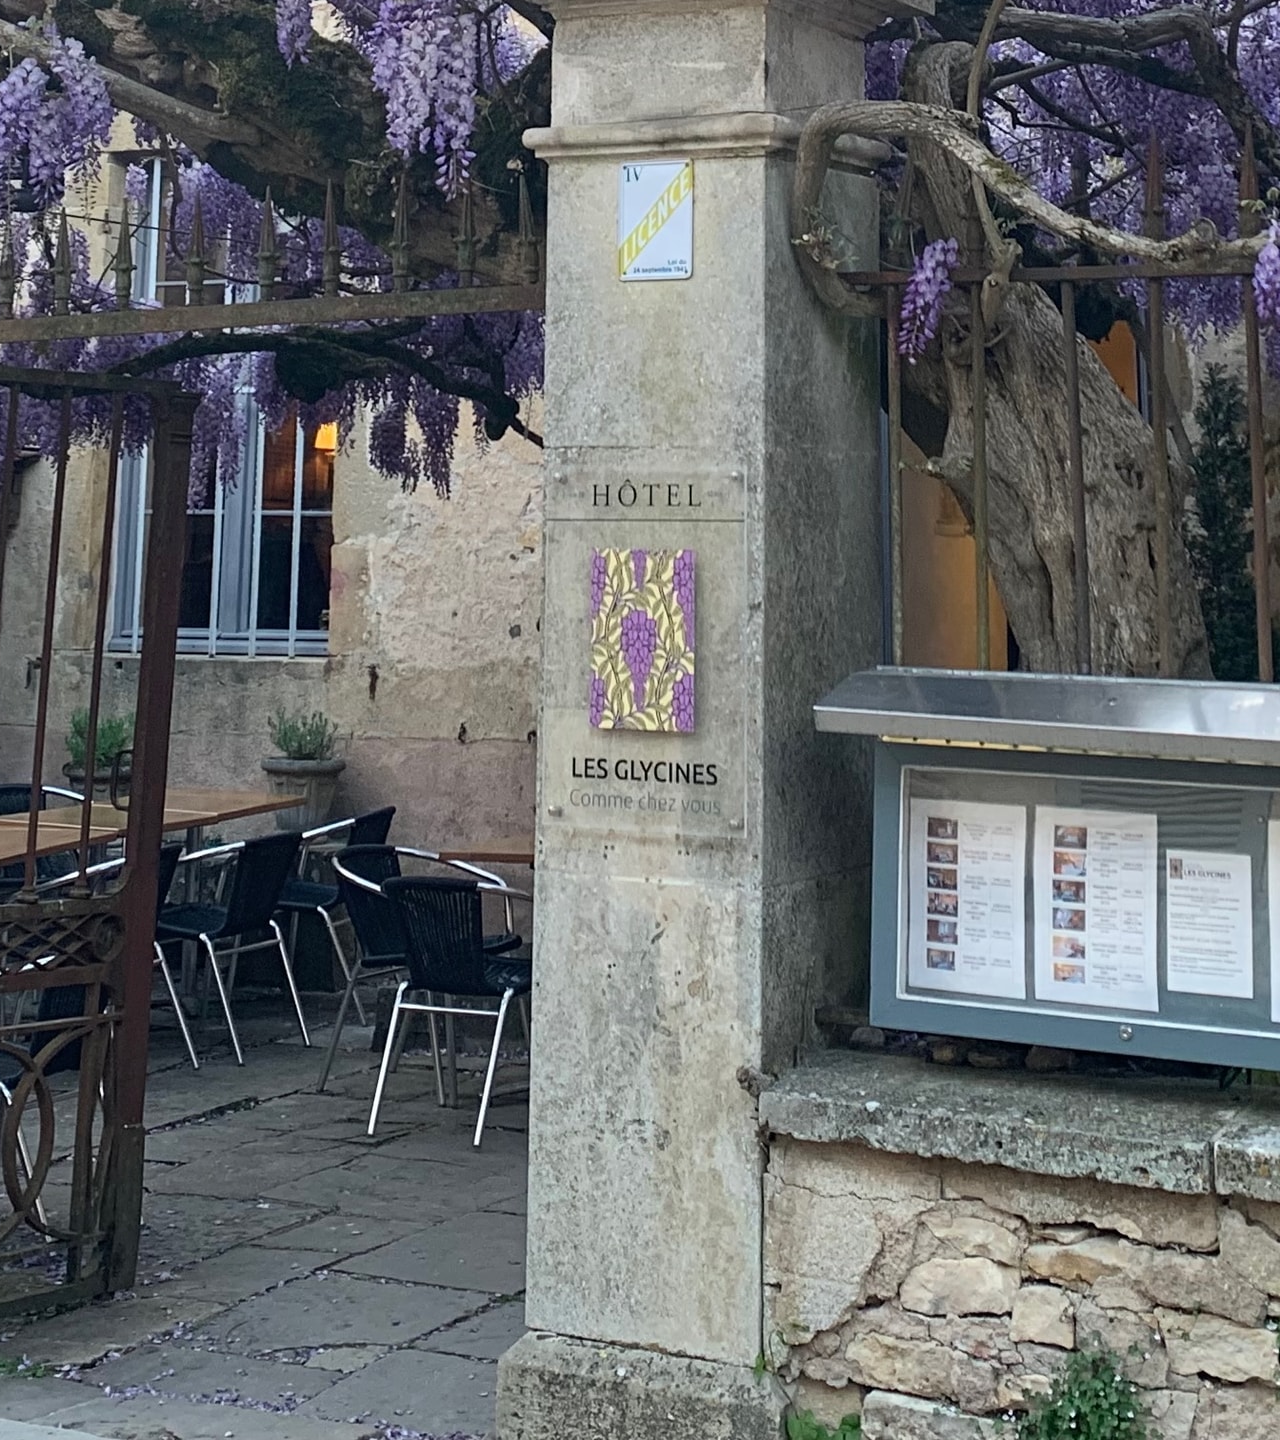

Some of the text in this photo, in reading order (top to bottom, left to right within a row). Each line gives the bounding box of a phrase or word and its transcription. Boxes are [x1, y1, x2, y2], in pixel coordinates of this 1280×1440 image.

[626, 167, 642, 182] IV
[623, 167, 690, 272] LICENCE
[592, 478, 702, 507] HÔTEL
[572, 757, 718, 786] LES GLYCINES
[569, 788, 721, 815] Comme chez vous
